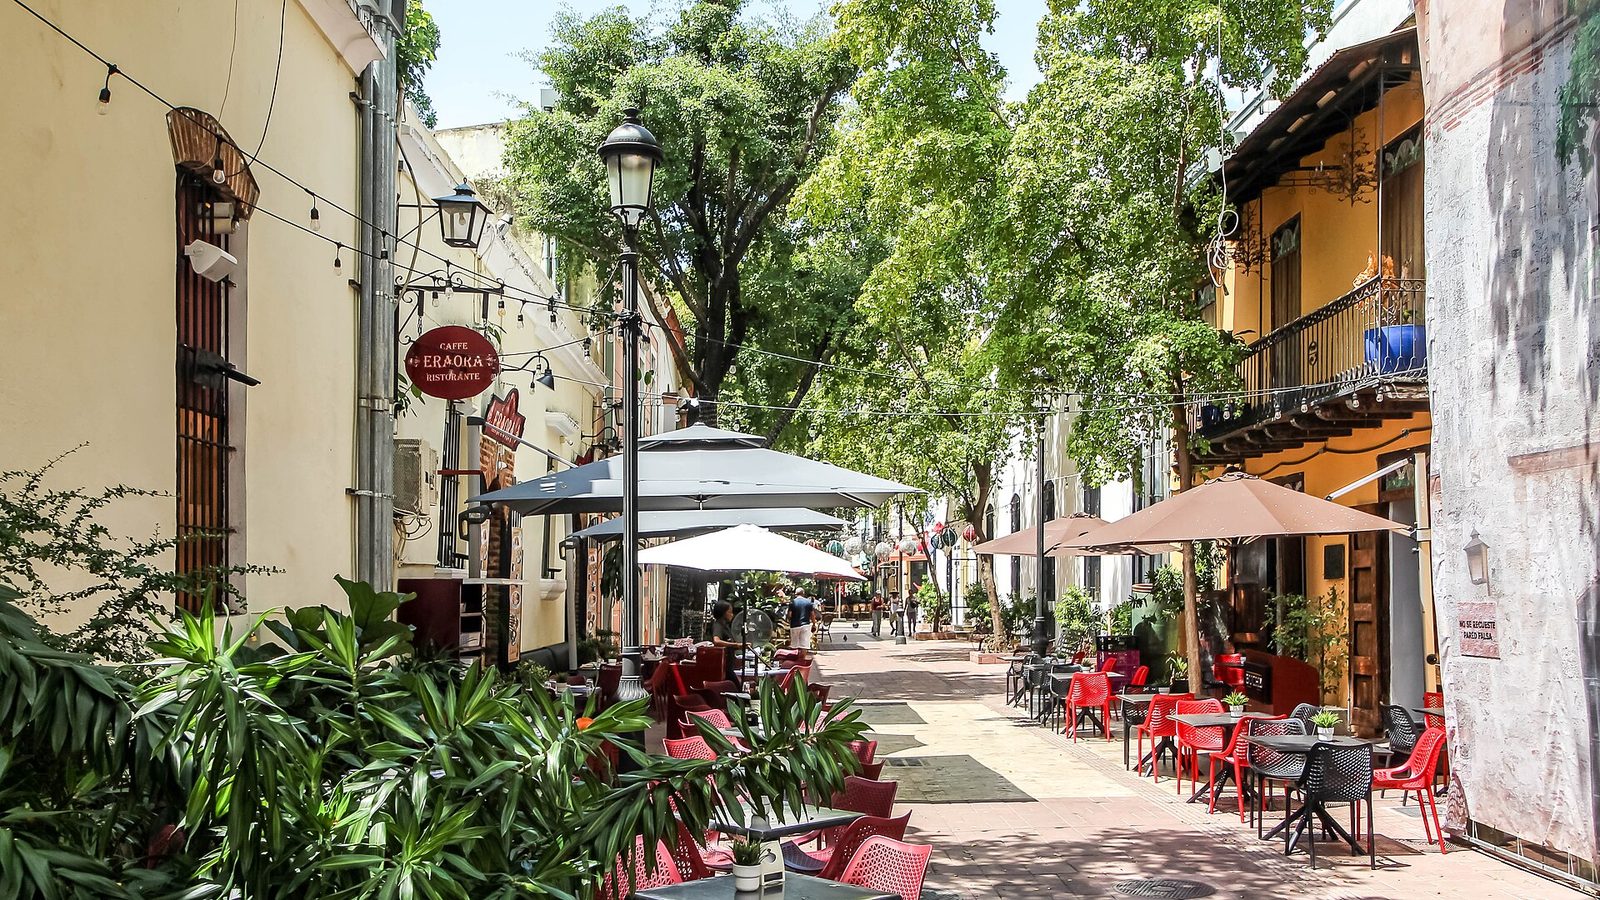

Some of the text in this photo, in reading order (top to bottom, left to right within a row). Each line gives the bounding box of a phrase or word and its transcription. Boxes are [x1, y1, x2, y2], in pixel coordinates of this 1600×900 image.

[440, 342, 468, 350] CAFFE
[426, 372, 480, 382] RISTORANTE
[1478, 631, 1493, 640] FALSA
